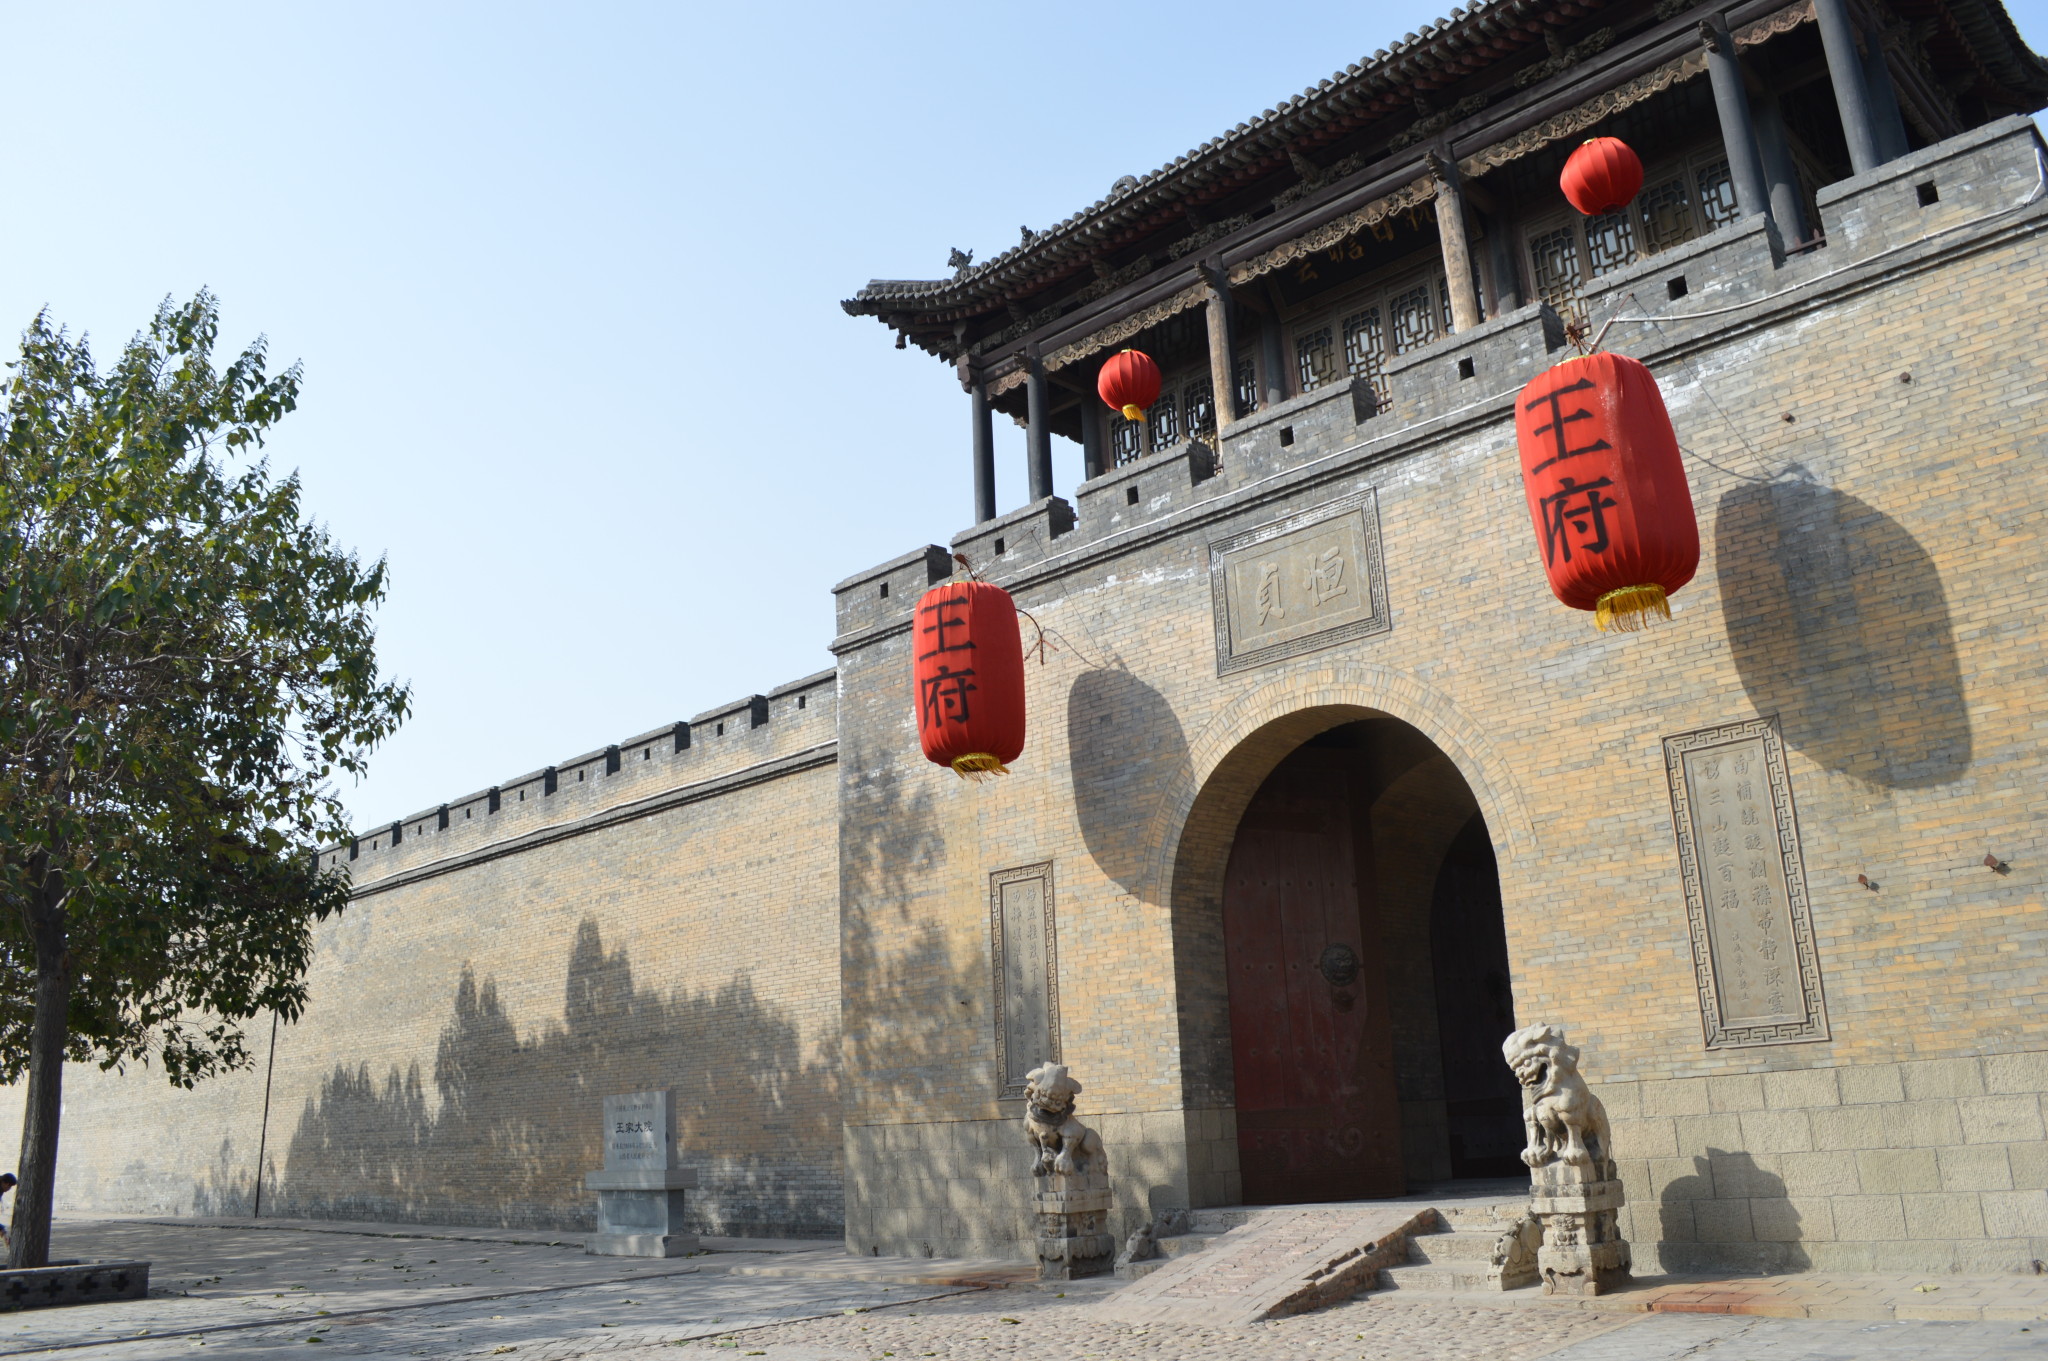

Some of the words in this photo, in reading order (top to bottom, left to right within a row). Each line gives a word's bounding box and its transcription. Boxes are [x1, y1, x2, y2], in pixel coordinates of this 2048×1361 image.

[1525, 377, 1617, 568] 王府
[919, 596, 978, 733] 王府
[616, 1121, 653, 1133] 王家大院
